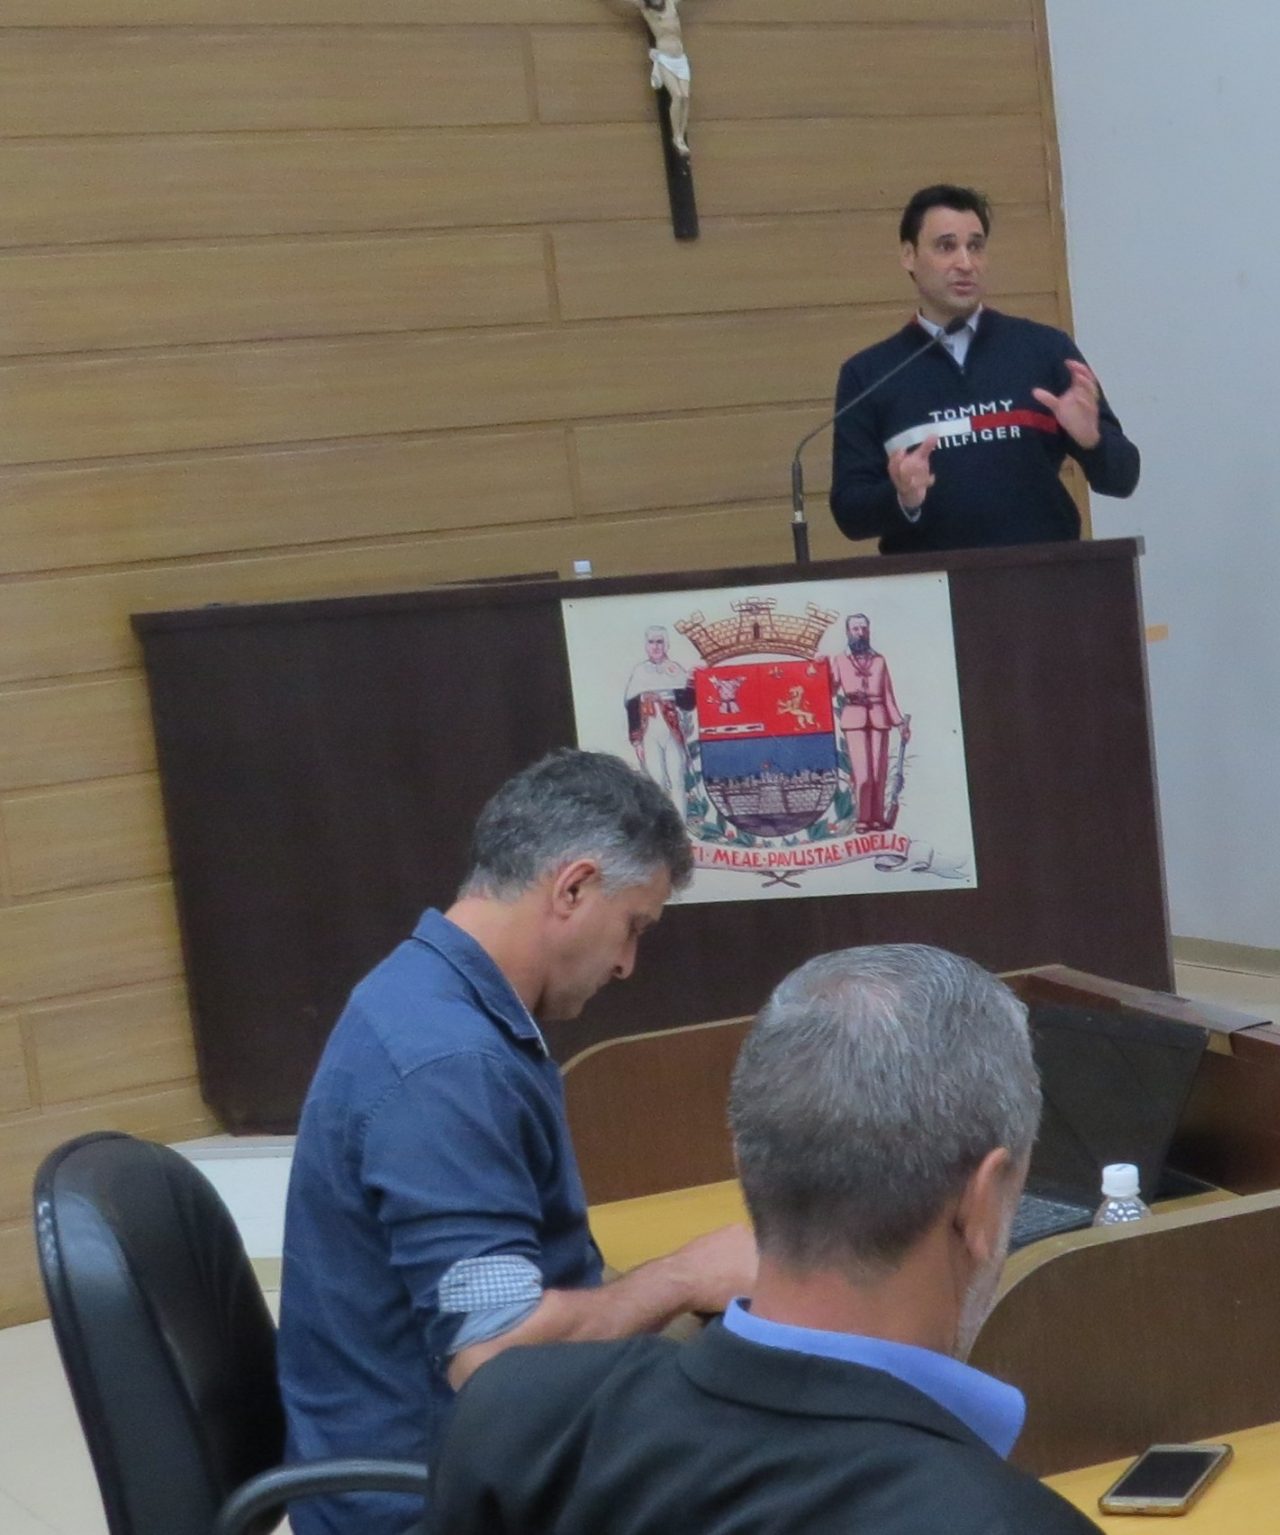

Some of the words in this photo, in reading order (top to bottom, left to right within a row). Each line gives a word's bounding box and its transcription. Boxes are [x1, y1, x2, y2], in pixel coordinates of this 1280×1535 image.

[928, 398, 1013, 423] TOMMY
[712, 847, 762, 867] MEAE
[767, 844, 842, 867] PAVLISTAE
[844, 833, 907, 857] FIDELIS
